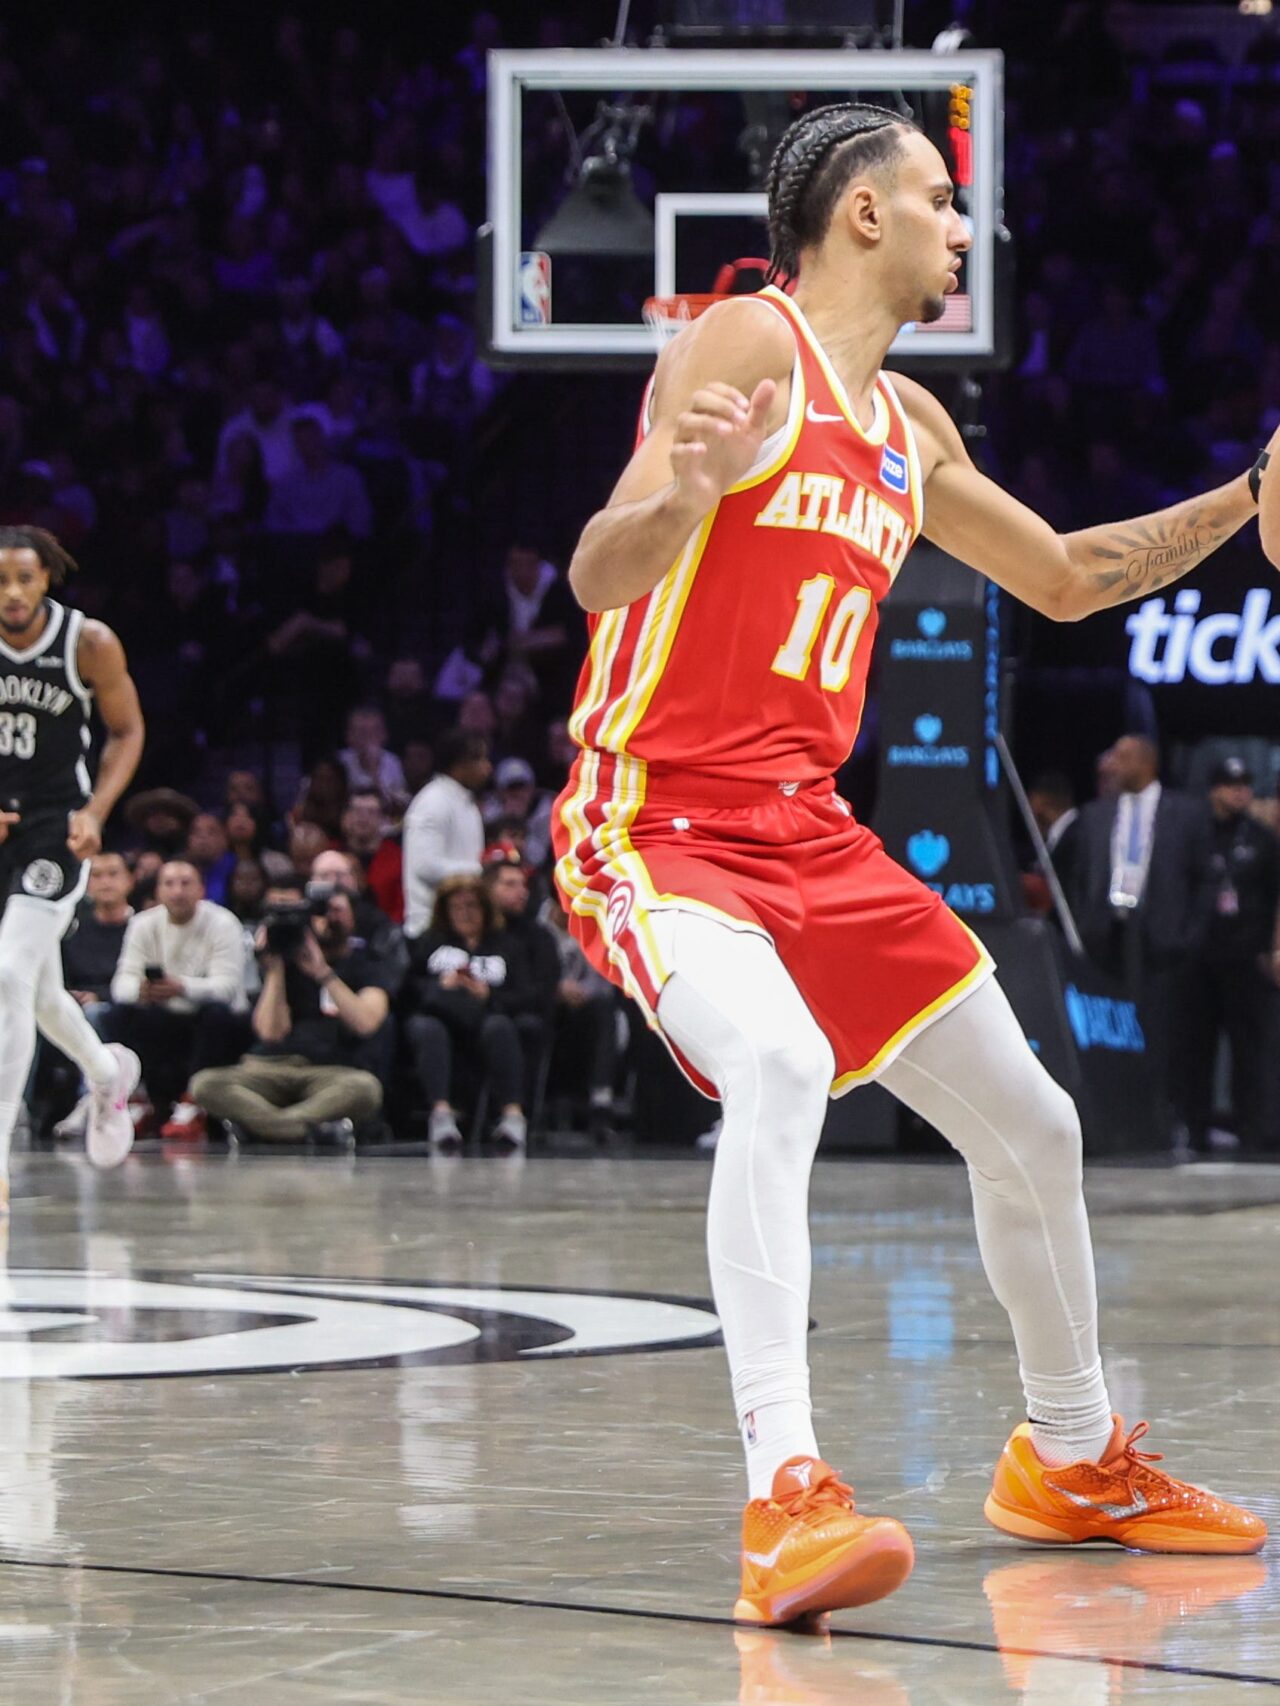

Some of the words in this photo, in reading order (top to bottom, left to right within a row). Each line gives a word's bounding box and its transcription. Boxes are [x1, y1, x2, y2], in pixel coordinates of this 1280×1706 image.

[1126, 525, 1212, 583] Family
[770, 572, 871, 693] 10
[0, 711, 37, 760] 33
